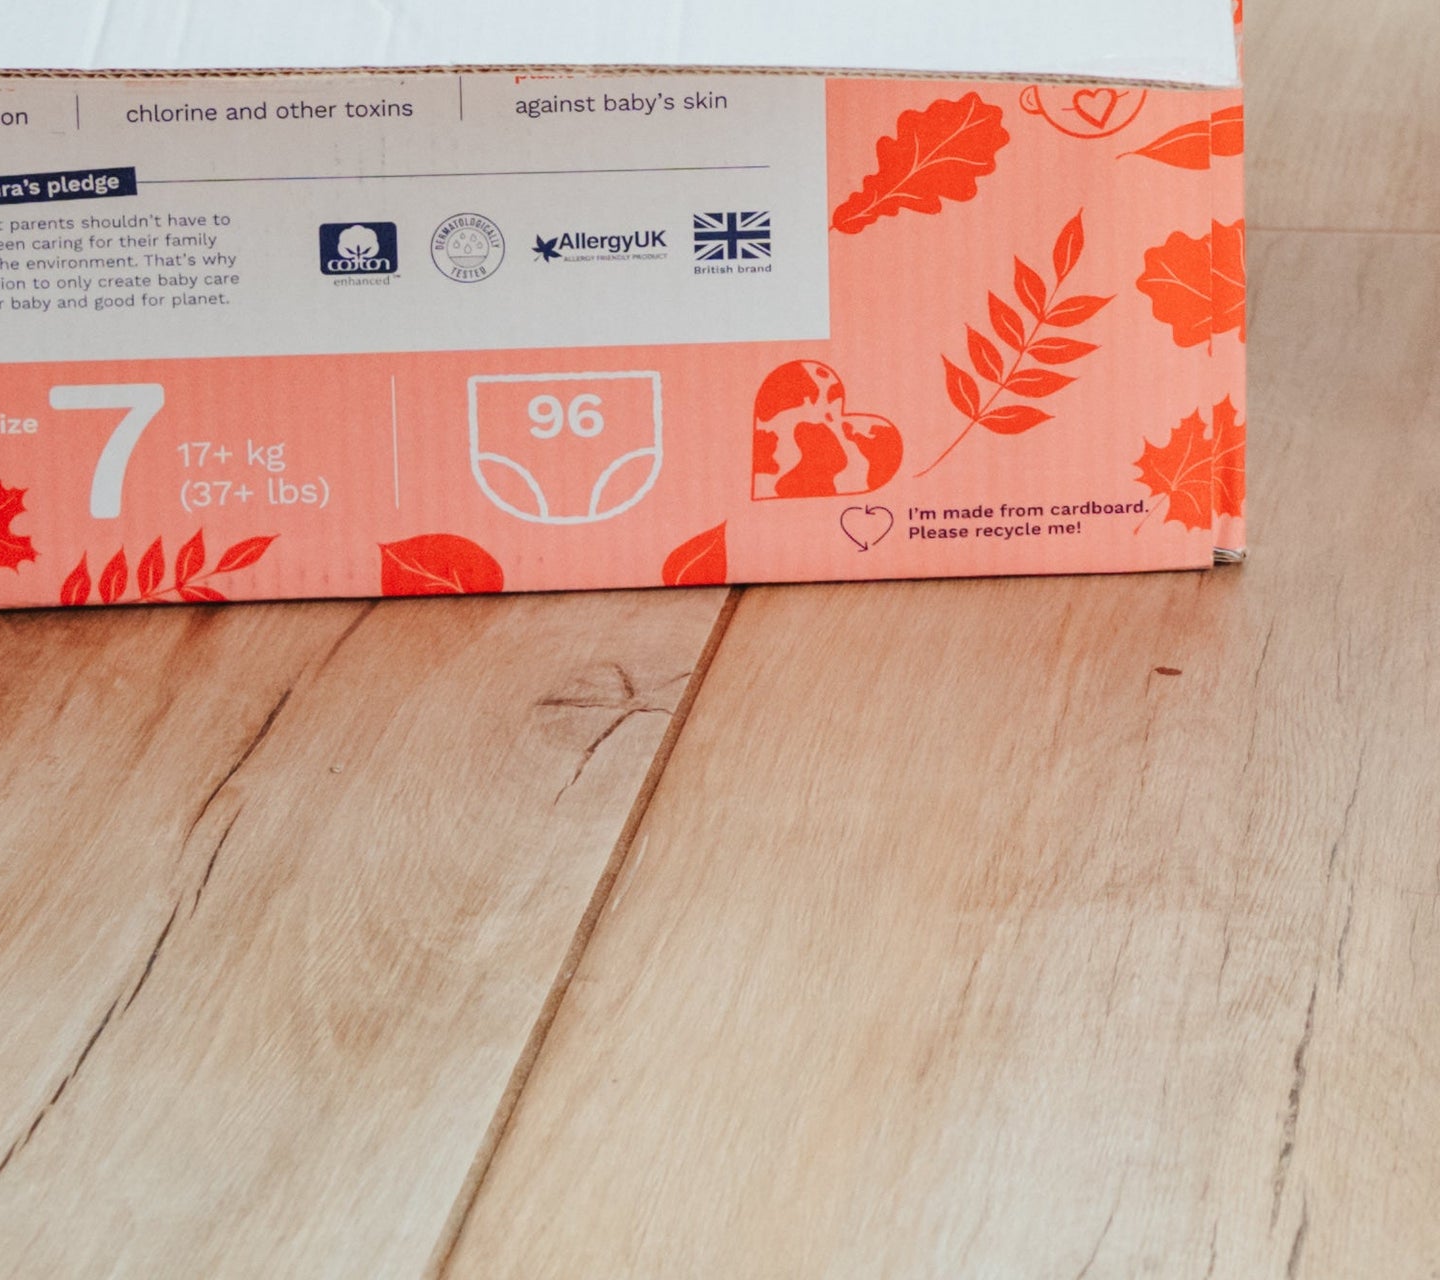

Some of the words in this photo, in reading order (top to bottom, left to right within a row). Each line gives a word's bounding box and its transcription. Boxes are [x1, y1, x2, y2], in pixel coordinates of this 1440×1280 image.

[126, 103, 217, 123] chlorine
[226, 101, 267, 121] and
[276, 100, 337, 119] other
[344, 99, 413, 118] toxins
[515, 95, 595, 119] against
[604, 92, 675, 116] baby's
[683, 91, 727, 110] skin
[47, 173, 119, 198] pledge
[10, 218, 74, 233] parents
[81, 214, 161, 229] shouldn't
[167, 213, 206, 226] have
[212, 214, 231, 226] to
[435, 216, 501, 251] DERMATOLOGICALLY
[31, 236, 83, 252] caring
[88, 235, 112, 248] for
[118, 234, 158, 248] their
[164, 232, 217, 249] family
[556, 230, 666, 253] AllergyUK
[25, 255, 138, 270] environment.
[143, 252, 196, 267] That's
[202, 252, 236, 268] why
[693, 265, 733, 274] British
[737, 263, 772, 273] brand
[32, 277, 50, 290] to
[56, 275, 92, 291] only
[97, 275, 151, 288] create
[158, 273, 198, 289] baby
[204, 274, 239, 286] care
[451, 267, 486, 279] TESTED
[10, 296, 51, 312] baby
[57, 295, 88, 309] and
[94, 293, 135, 311] good
[141, 293, 165, 306] for
[171, 292, 229, 308] planet.
[527, 393, 604, 440] 96
[48, 382, 165, 519] 7
[177, 441, 233, 467] 17+
[247, 438, 286, 473] kg
[180, 479, 254, 513] (37+
[268, 476, 330, 508] lbs)
[908, 507, 936, 520] I'm
[943, 504, 994, 519] made
[999, 503, 1043, 517] from
[1050, 499, 1149, 515] cardboard.
[909, 525, 968, 539] Please
[975, 522, 1041, 540] recycle
[1048, 521, 1080, 534] me!
